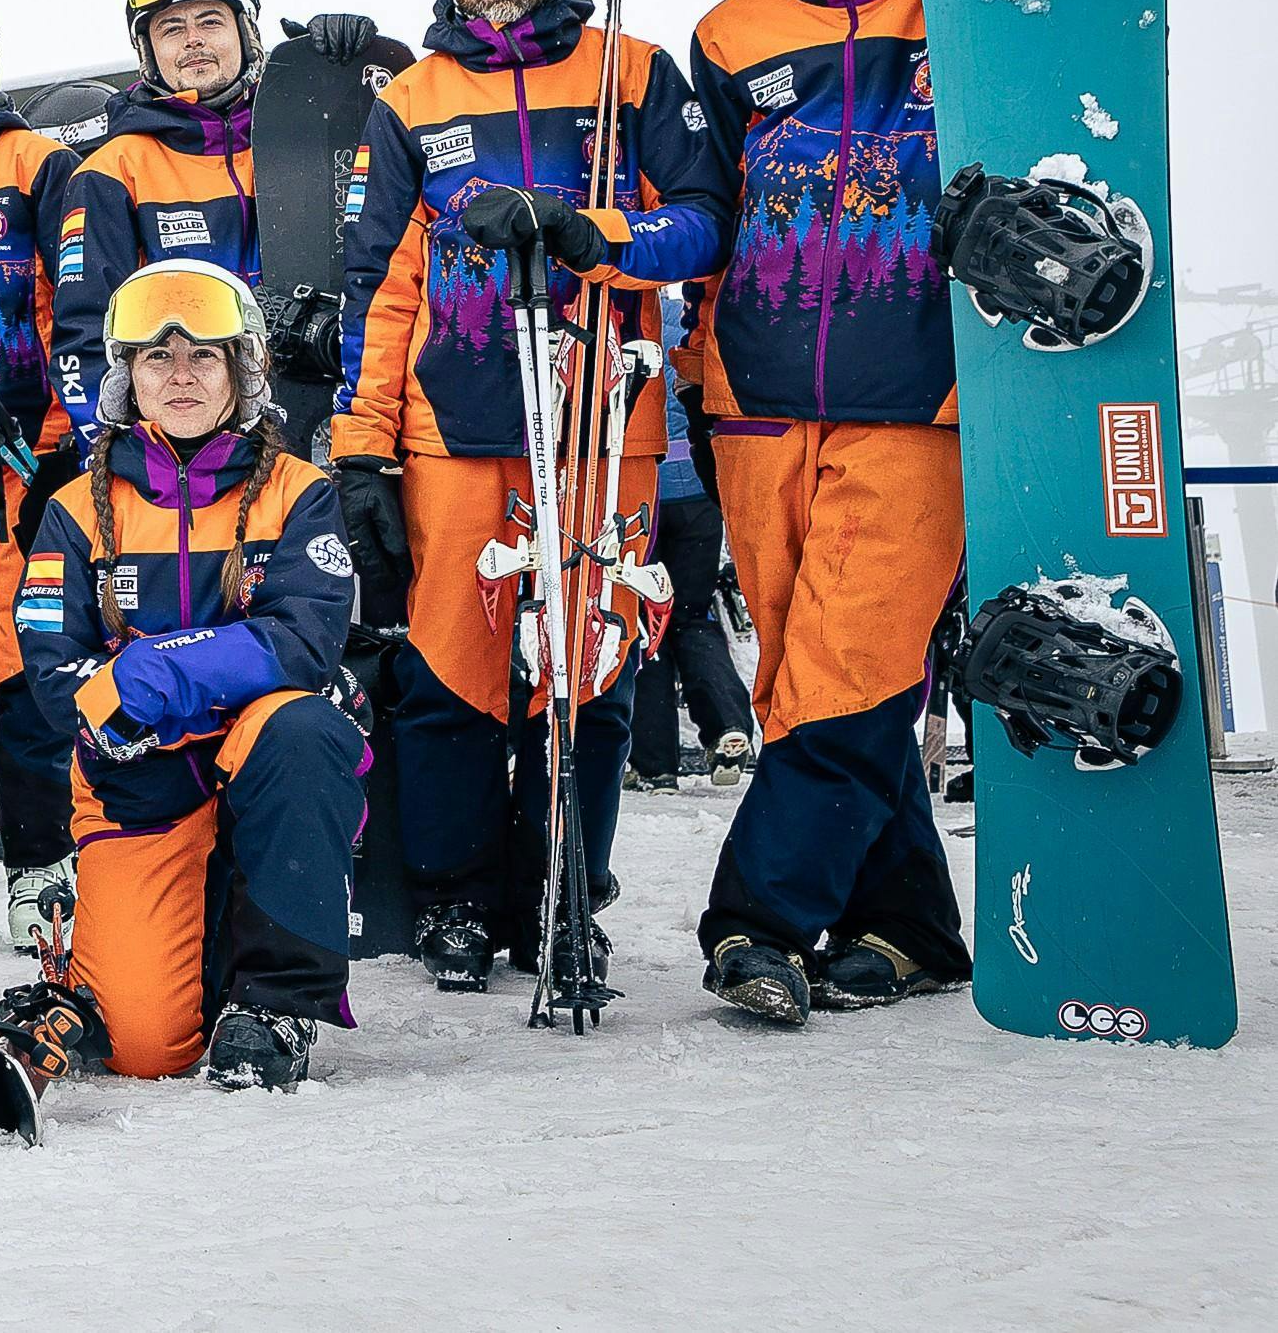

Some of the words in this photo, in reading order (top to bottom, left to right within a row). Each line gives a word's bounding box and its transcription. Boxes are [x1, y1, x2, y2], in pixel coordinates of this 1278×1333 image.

[435, 137, 470, 152] ULLER
[440, 152, 472, 168] Suntribe
[172, 221, 204, 231] ULLER
[175, 234, 207, 244] Suntribe
[59, 354, 88, 405] SKI
[1140, 414, 1149, 450] COMPANY
[1112, 413, 1143, 482] UNION
[153, 629, 216, 649] VITALINI
